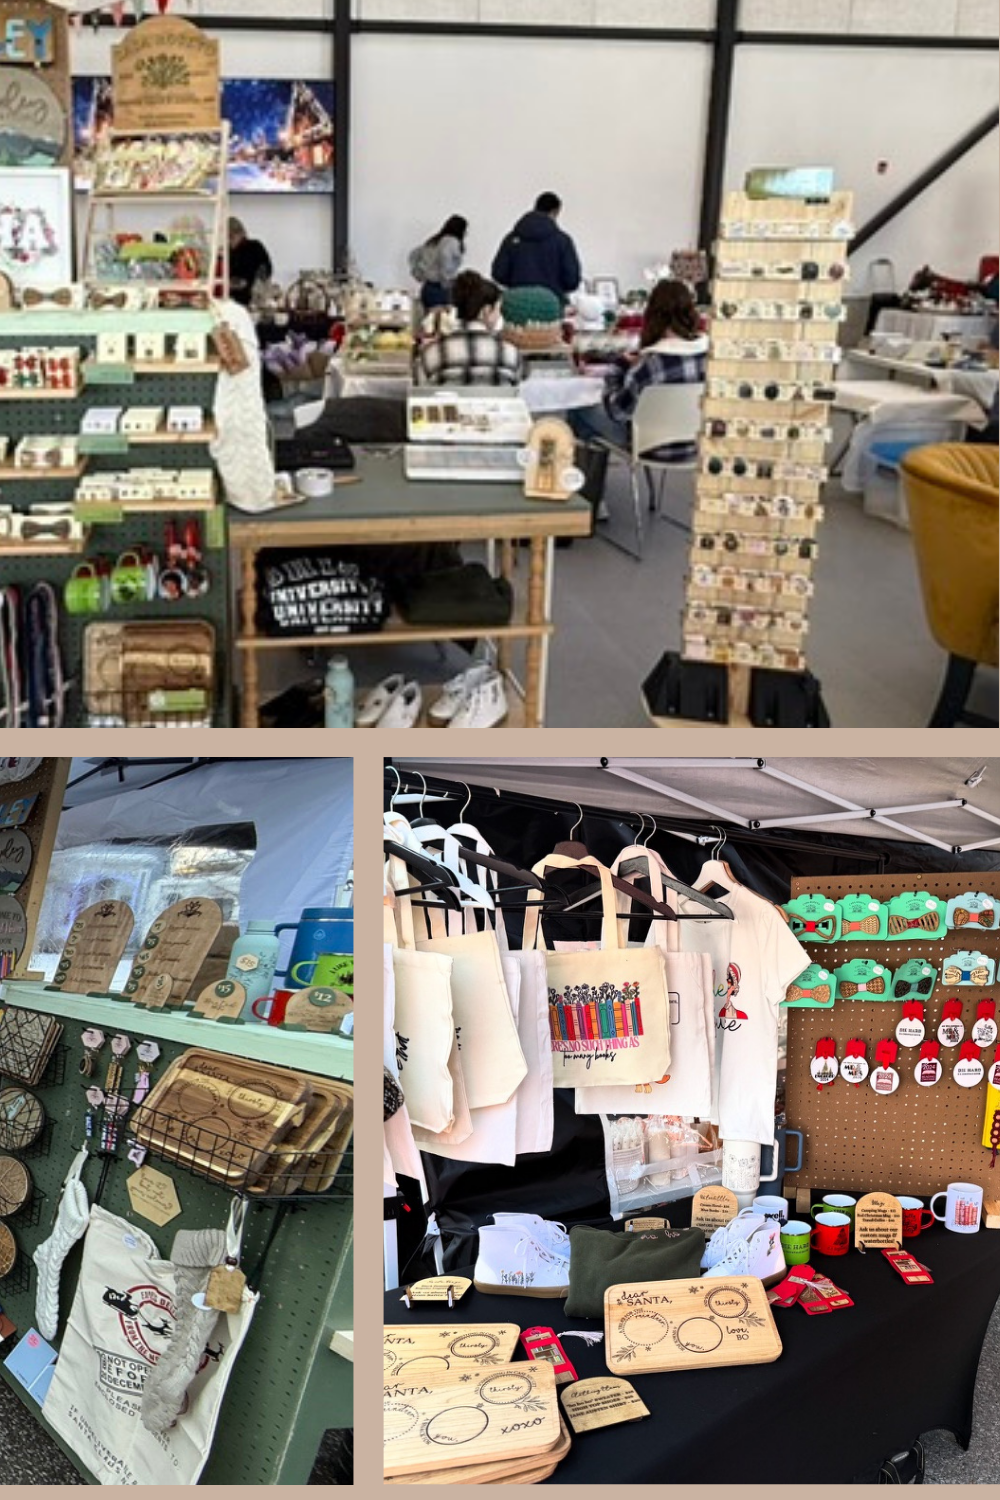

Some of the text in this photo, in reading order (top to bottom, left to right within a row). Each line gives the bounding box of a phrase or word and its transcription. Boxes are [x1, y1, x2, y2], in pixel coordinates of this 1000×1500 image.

[313, 991, 333, 1002] $12
[569, 1036, 640, 1051] NO SUCH THING AS
[573, 1047, 616, 1069] many books
[620, 1291, 649, 1300] dear
[626, 1296, 673, 1307] SANTA,
[107, 1356, 128, 1369] NOT
[500, 1416, 546, 1435] xoxo
